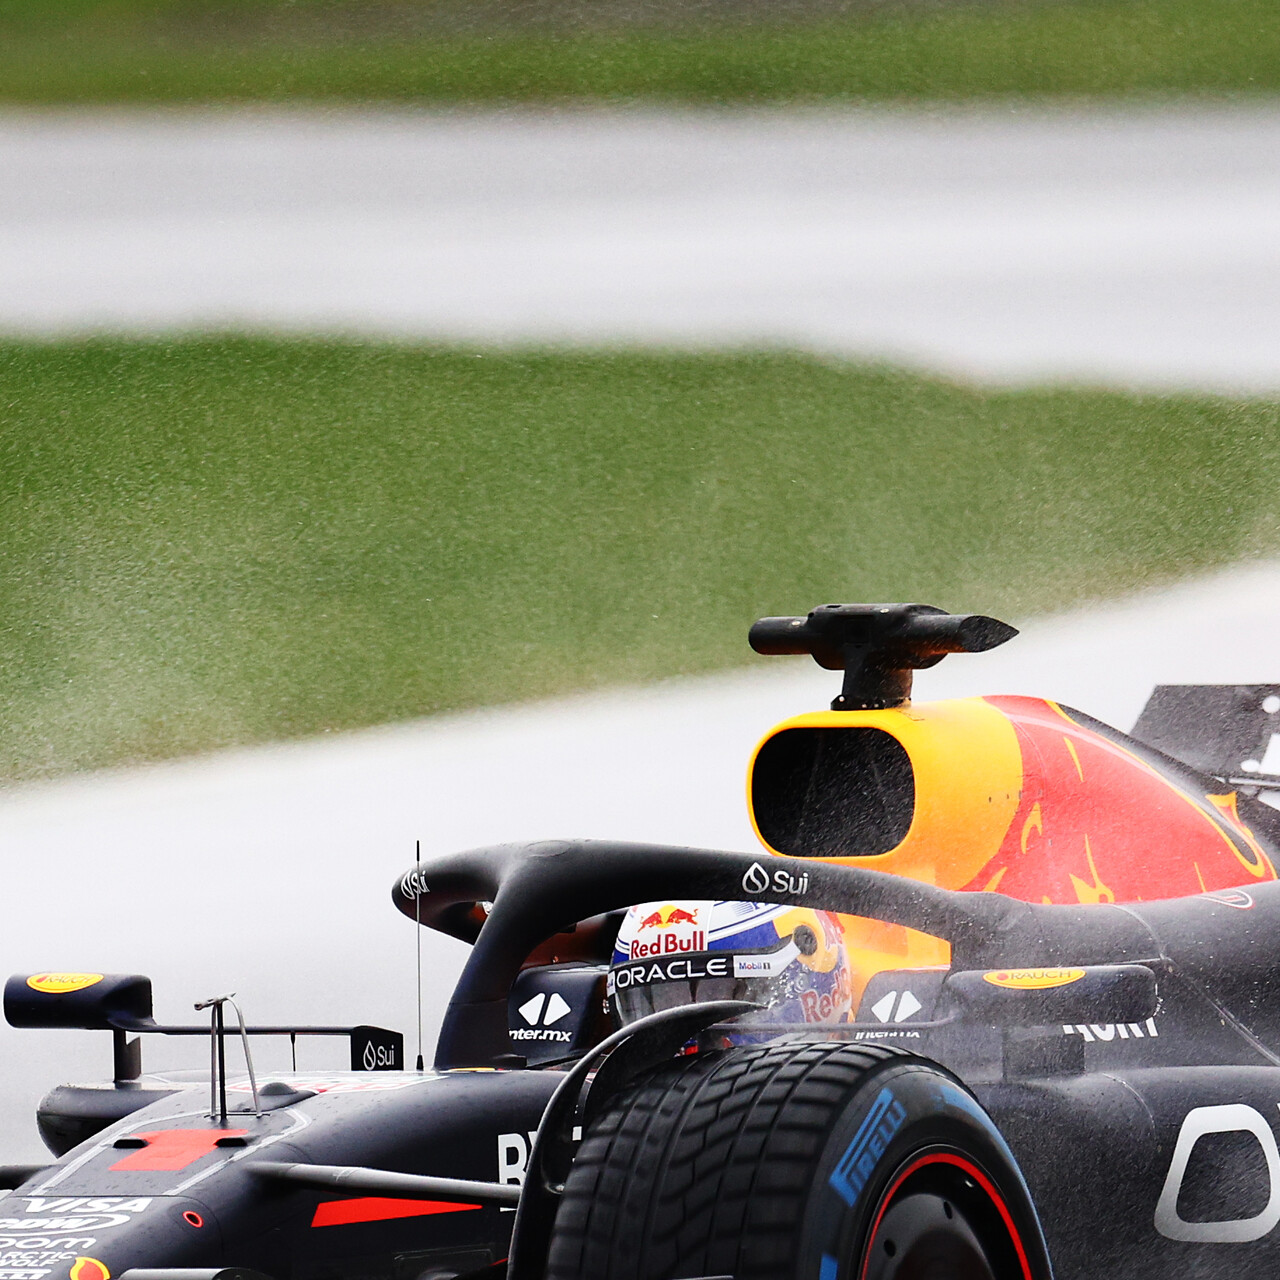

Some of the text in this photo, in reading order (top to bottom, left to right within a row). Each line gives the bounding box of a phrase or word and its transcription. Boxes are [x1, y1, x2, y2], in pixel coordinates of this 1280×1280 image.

[772, 870, 809, 895] Sui
[630, 930, 705, 960] Red Bull
[616, 958, 728, 989] ORACLE
[738, 962, 762, 970] Mobil
[1010, 970, 1072, 980] RAUCH
[508, 1028, 572, 1042] nter.mx
[376, 1044, 395, 1066] Sui
[828, 1087, 908, 1208] PIRELLI
[22, 1198, 153, 1213] VISA
